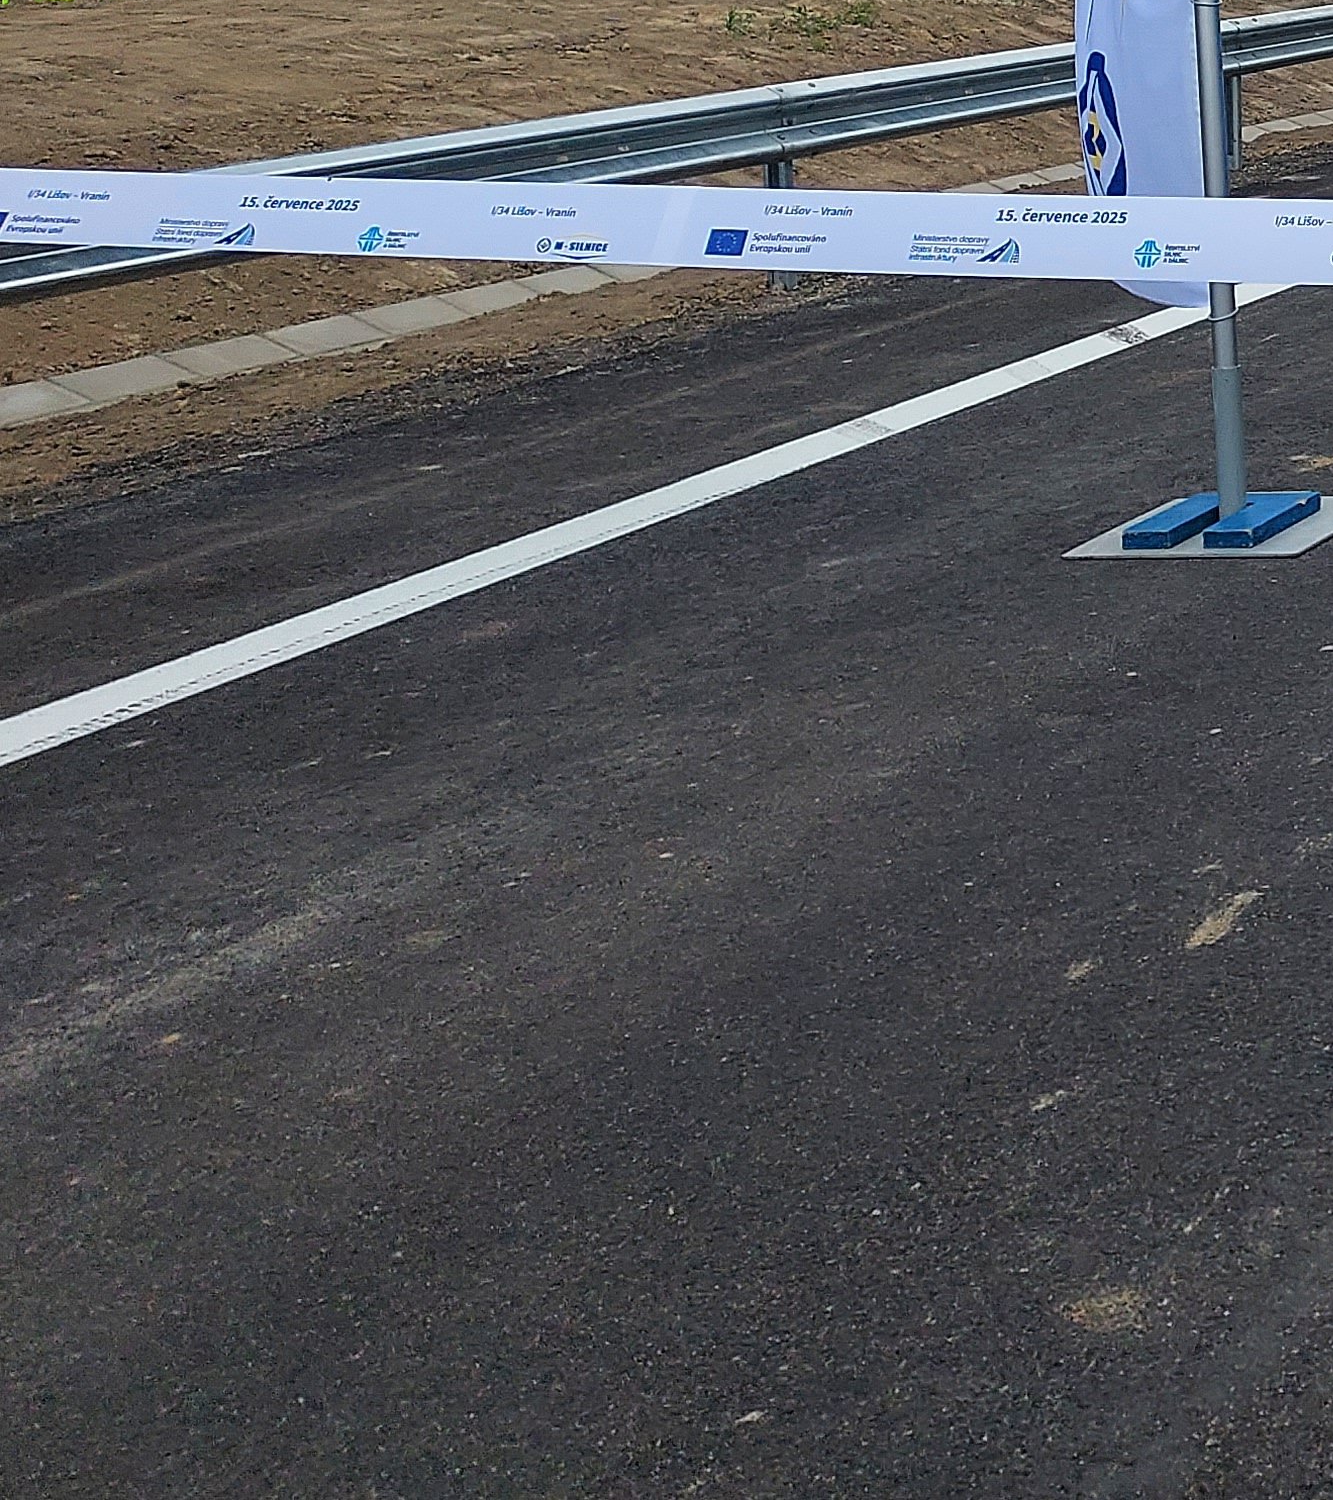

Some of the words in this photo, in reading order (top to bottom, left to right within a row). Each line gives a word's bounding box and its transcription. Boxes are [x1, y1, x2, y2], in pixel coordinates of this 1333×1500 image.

[239, 196, 258, 208] 15.
[263, 195, 323, 210] července
[325, 199, 360, 211] 2025
[764, 206, 783, 216] I/34
[785, 205, 811, 216] Lišov
[821, 207, 853, 217] Vranín
[996, 209, 1017, 222] 15.
[1022, 208, 1088, 223] července
[1090, 211, 1127, 224] 2025
[1275, 216, 1295, 227] I/34
[1297, 215, 1324, 227] Lišov
[752, 232, 827, 243] Spolufinancováno
[749, 244, 793, 254] Evropskou
